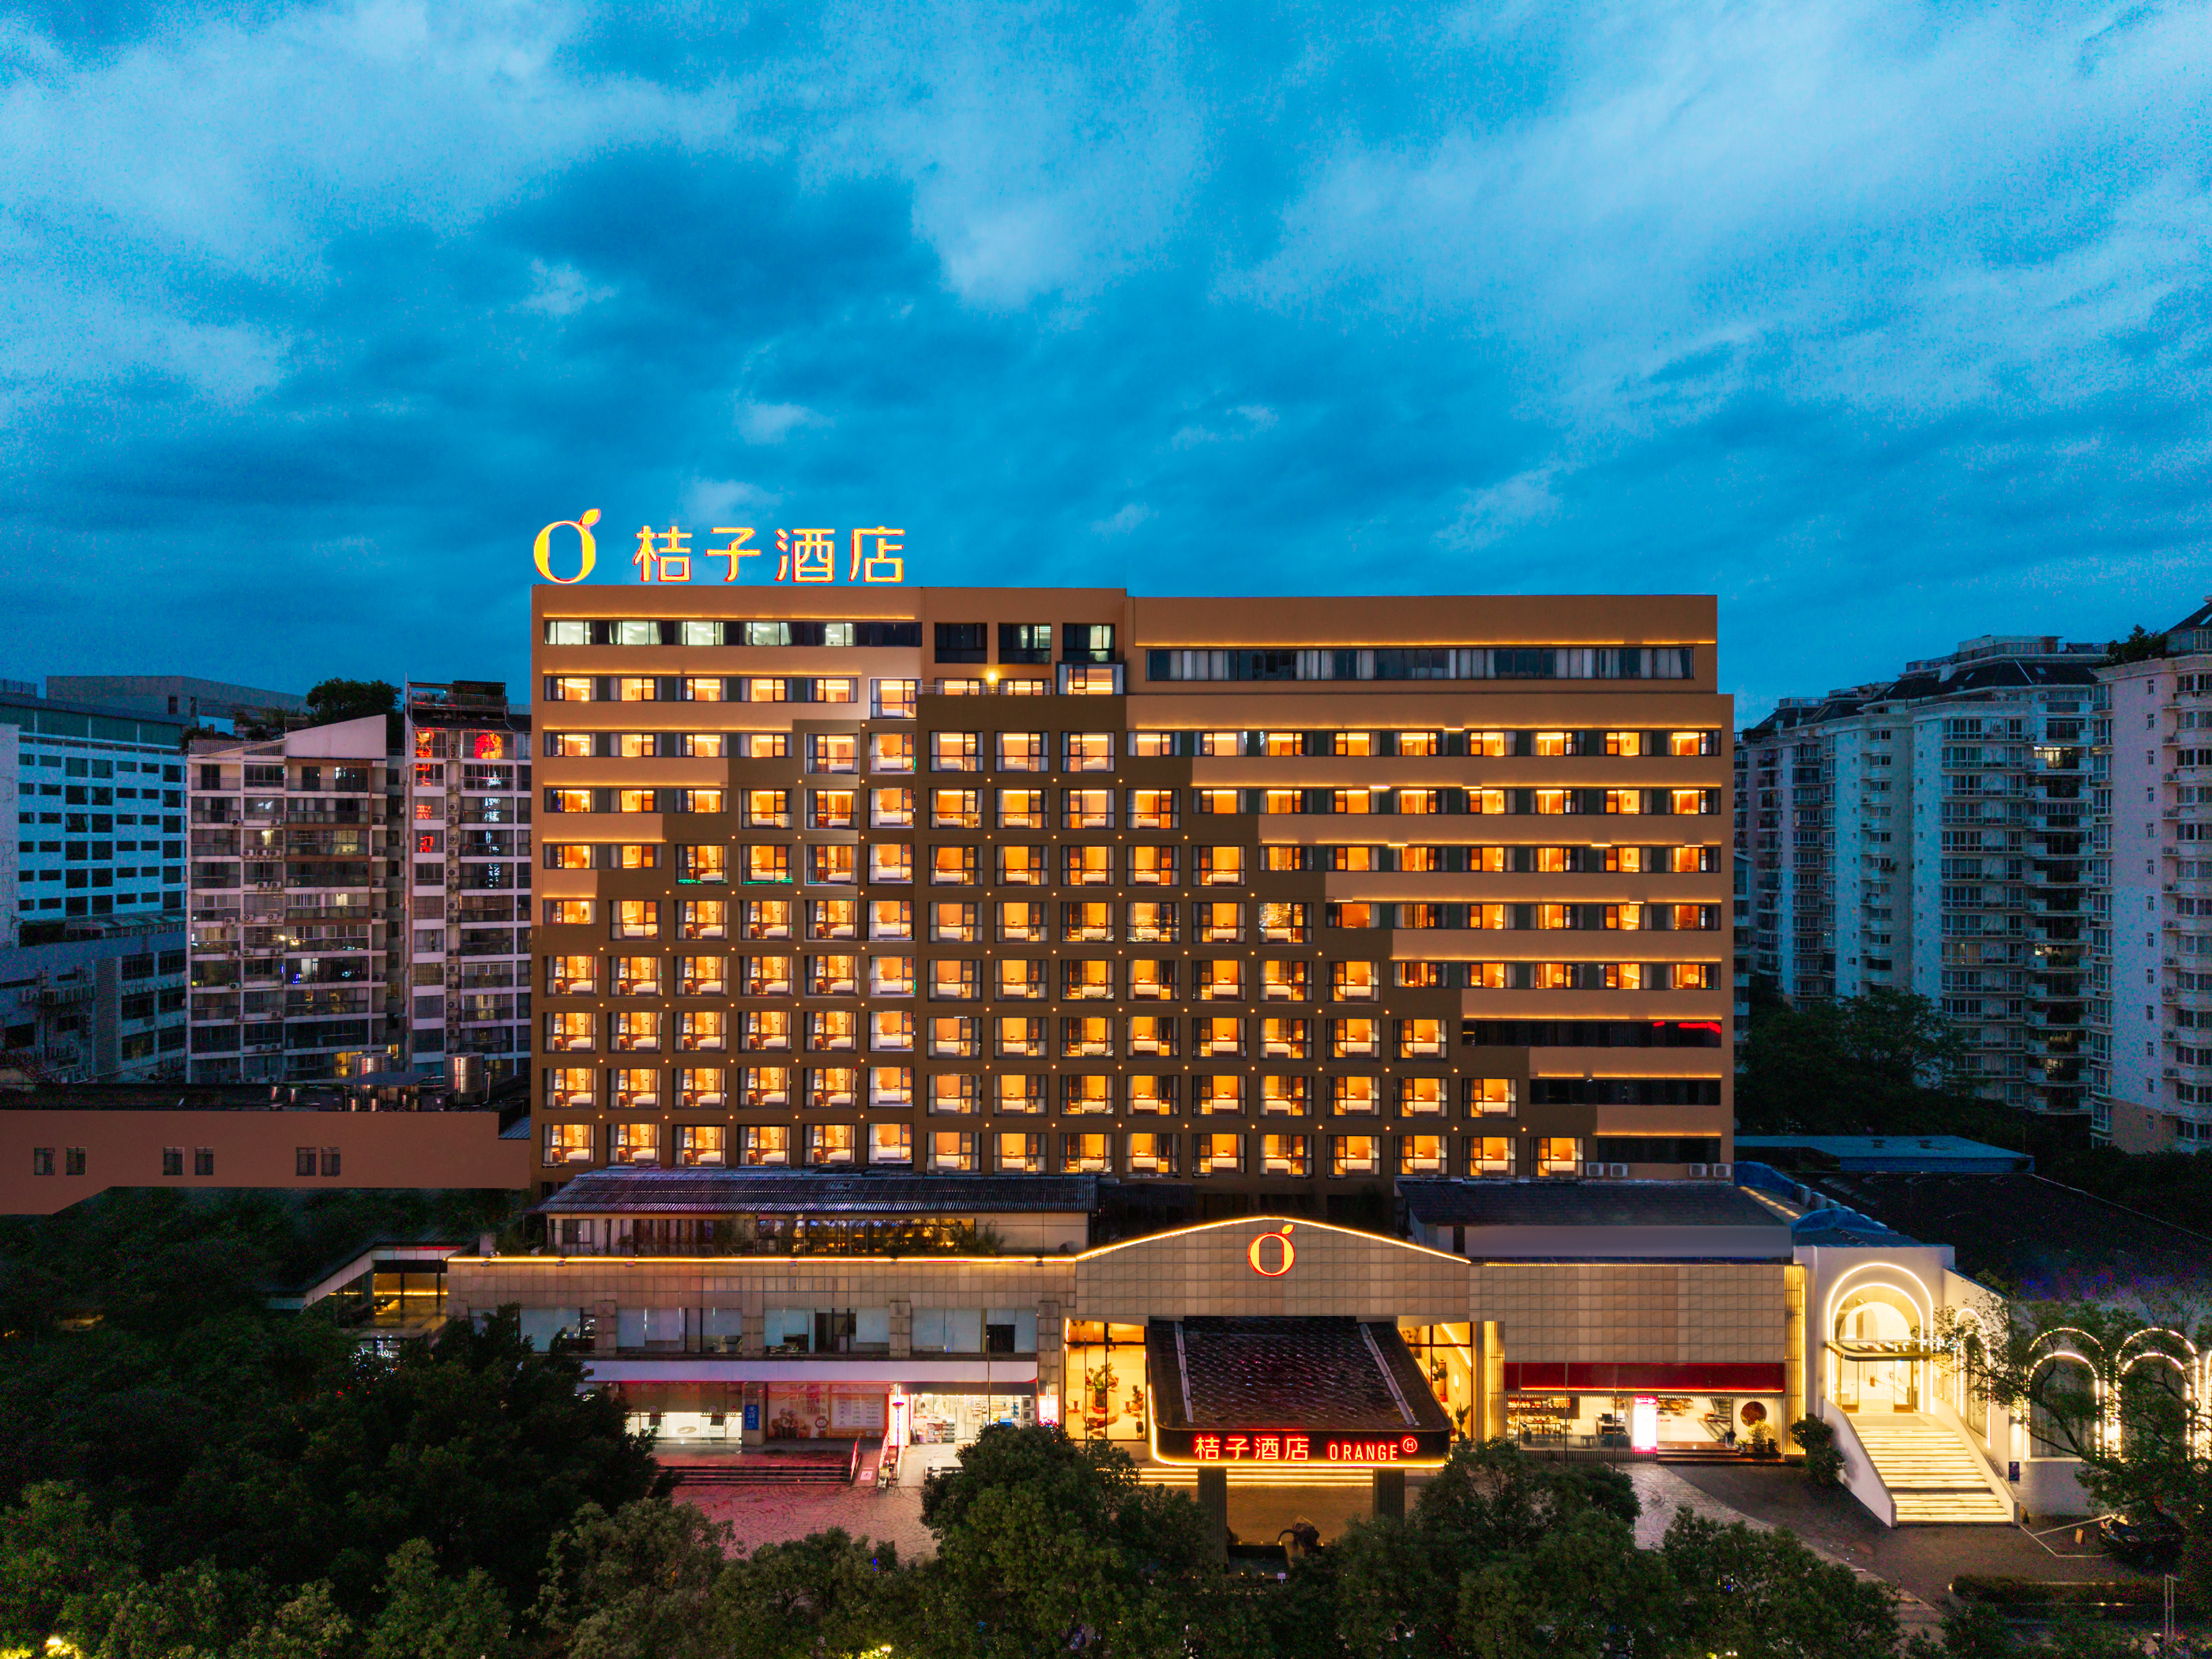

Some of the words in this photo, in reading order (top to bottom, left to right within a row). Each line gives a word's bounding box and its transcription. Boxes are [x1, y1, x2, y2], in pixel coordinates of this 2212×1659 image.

[633, 525, 905, 582] 桔子酒店
[1194, 1436, 1309, 1461] 桔子酒店
[1329, 1443, 1398, 1462] ORANGE
